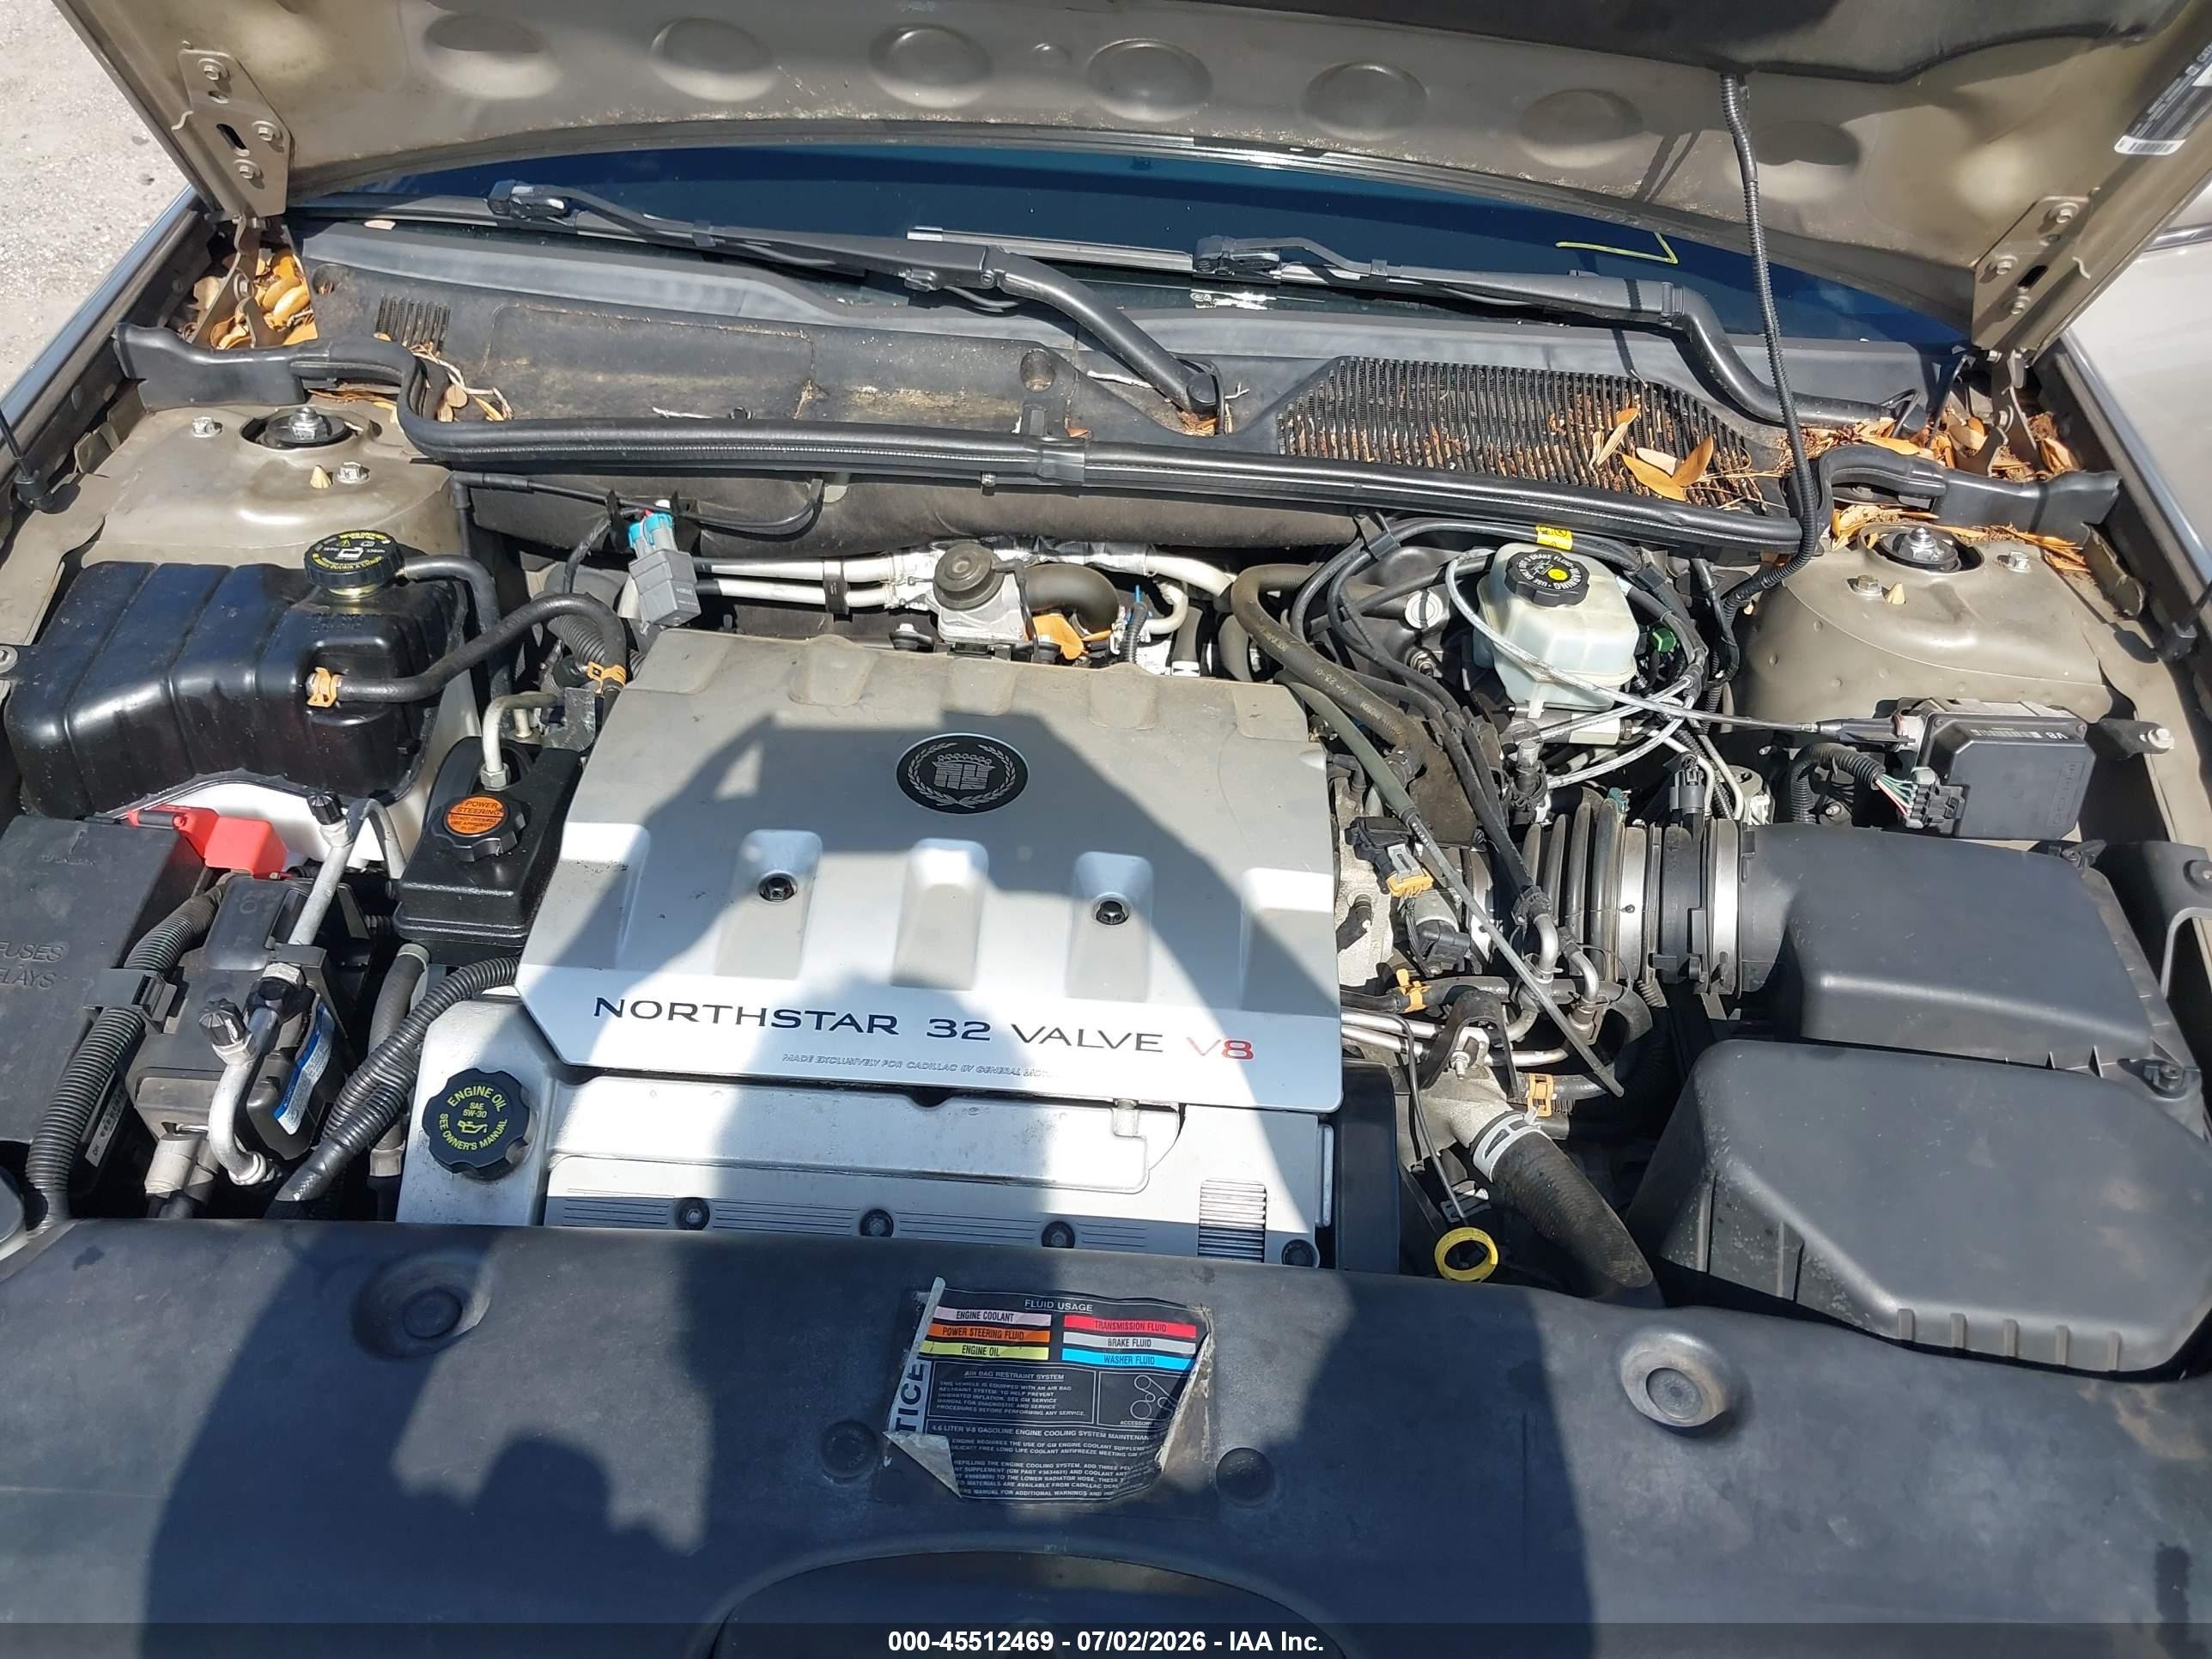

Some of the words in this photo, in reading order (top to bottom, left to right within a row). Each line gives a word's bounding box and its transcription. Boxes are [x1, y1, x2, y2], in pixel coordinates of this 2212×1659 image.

[1554, 556, 1573, 567] FLUID
[1553, 568, 1582, 590] WARNING
[465, 800, 498, 809] POWER
[594, 996, 900, 1036] NORTHSTAR
[926, 1018, 992, 1042] 32
[1010, 1024, 1164, 1053] VALVE
[1185, 1037, 1255, 1060] V8
[782, 1053, 814, 1063] MADE
[815, 1055, 881, 1067] EXCLUSIVELY
[882, 1059, 903, 1068] FOR
[906, 1061, 957, 1072] CADILLAC
[960, 1064, 975, 1073] BY
[975, 1065, 1021, 1076] GENERAL
[447, 1085, 494, 1107] ENGINE
[491, 1094, 507, 1112] OIL
[462, 1109, 488, 1118] 5W-30
[440, 1113, 448, 1130] SEE
[479, 1118, 507, 1148] MANUAL
[442, 1130, 477, 1151] OWNER'S
[1024, 1298, 1054, 1310] FLUID
[1056, 1301, 1093, 1312] USAGE
[956, 1310, 981, 1320] ENGINE
[982, 1312, 1014, 1322] COOLANT
[943, 1327, 967, 1336] POWER
[969, 1328, 1002, 1339] STEERING
[1005, 1329, 1024, 1340] FLUID
[1094, 1321, 1146, 1331] TRANSMISSION
[1147, 1322, 1166, 1333] FLUID
[1108, 1338, 1130, 1347] BRAKE
[1132, 1339, 1152, 1347] FLUID
[962, 1345, 987, 1356] ENGINE
[989, 1346, 1000, 1357] OIL
[1103, 1355, 1133, 1364] WASHER
[1135, 1356, 1155, 1365] FLUID
[896, 1363, 924, 1431] TICE
